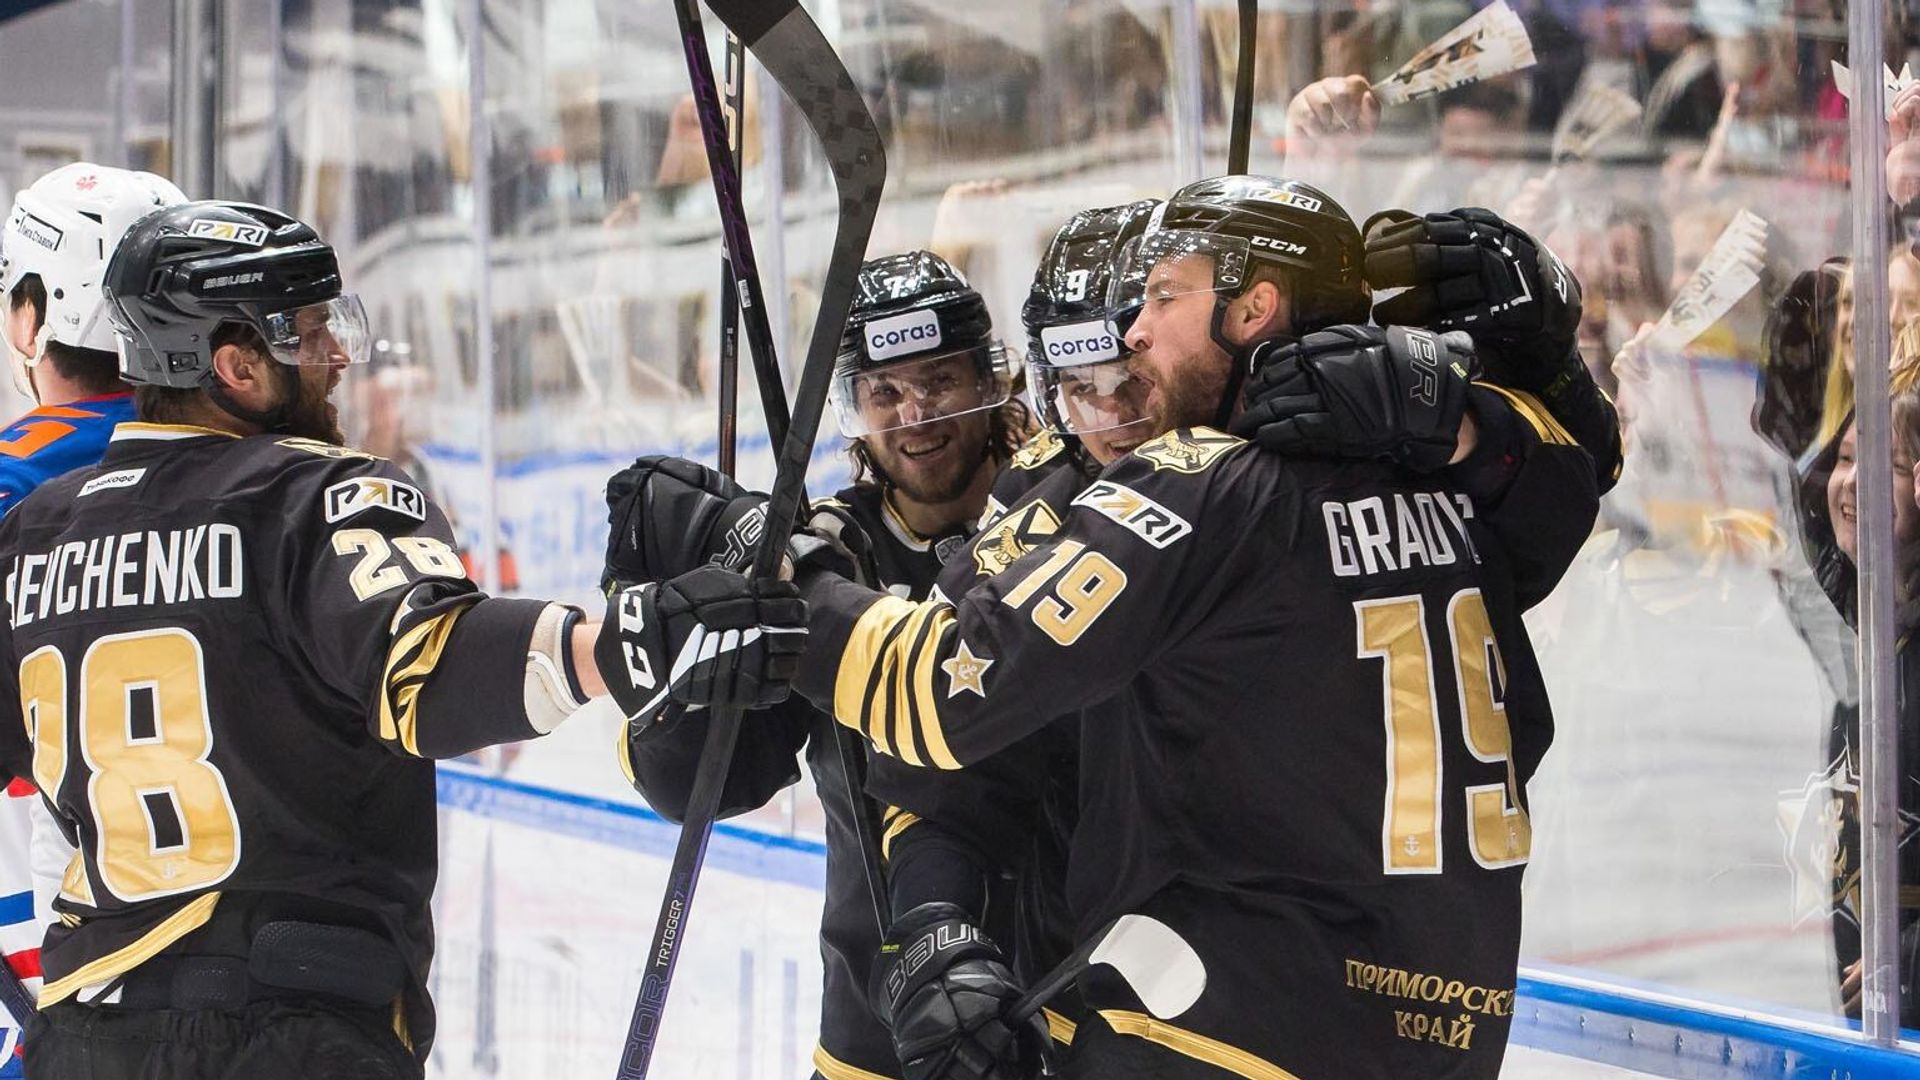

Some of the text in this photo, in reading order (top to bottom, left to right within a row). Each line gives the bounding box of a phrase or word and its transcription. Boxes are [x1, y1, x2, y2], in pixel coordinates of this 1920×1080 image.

[193, 222, 264, 243] PARI
[1250, 235, 1308, 255] CCM
[1065, 268, 1090, 302] 9
[330, 480, 423, 517] PARI
[1077, 485, 1183, 543] PARI
[331, 528, 467, 602] 28
[1000, 539, 1128, 647] 19
[1352, 587, 1532, 876] 19
[656, 898, 684, 967] TRIGGER
[1394, 1010, 1476, 1050] КРАЙ
